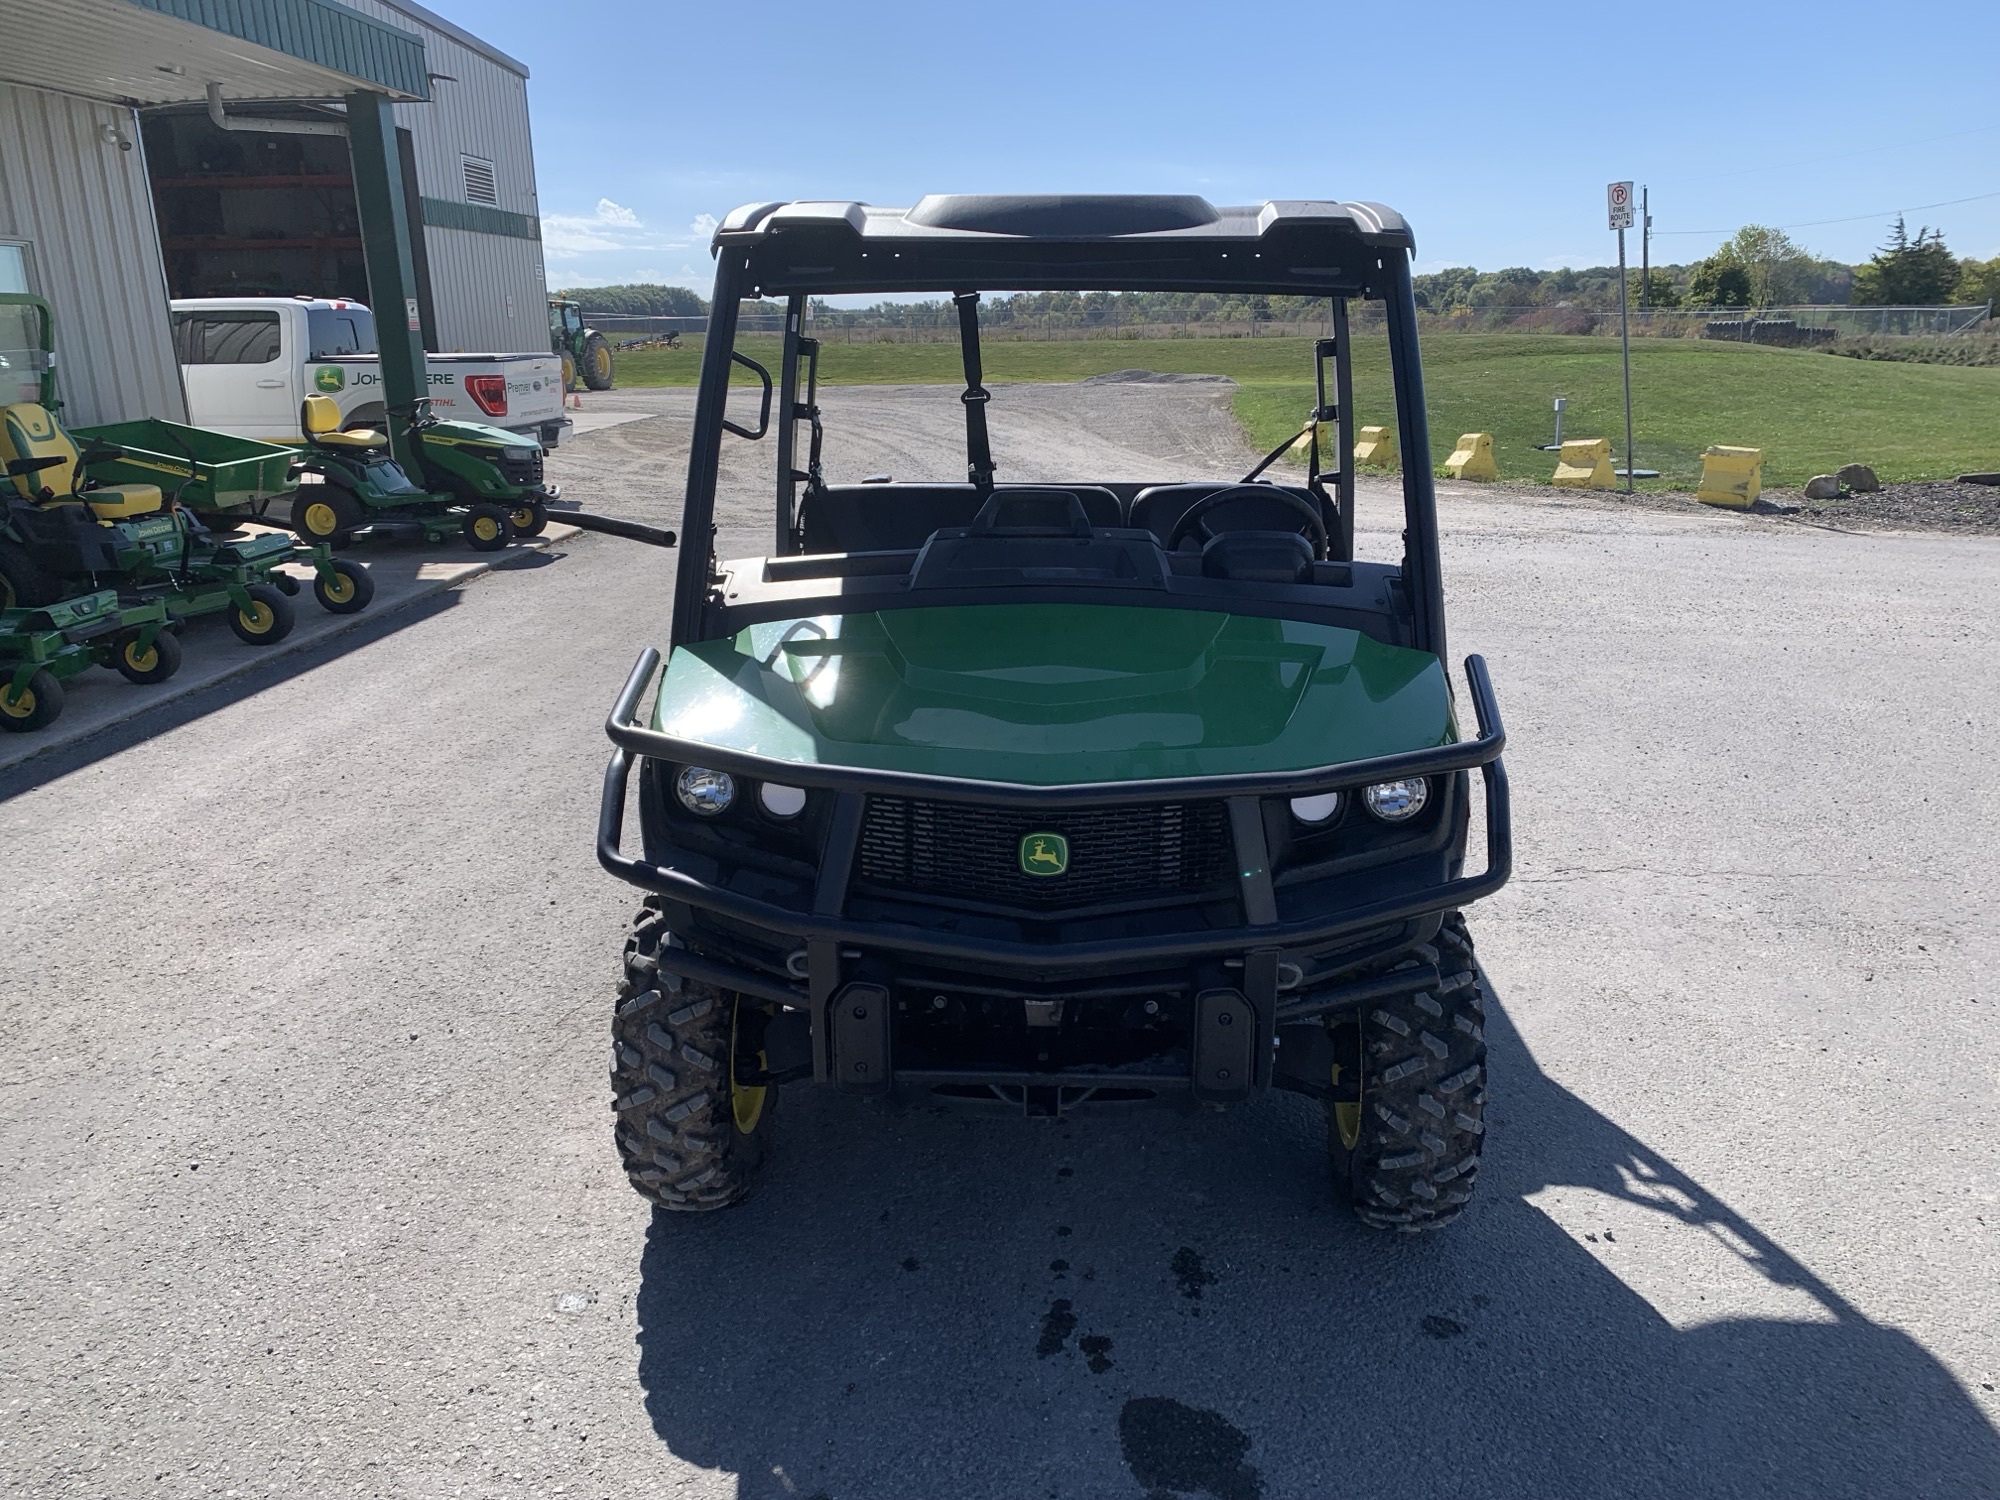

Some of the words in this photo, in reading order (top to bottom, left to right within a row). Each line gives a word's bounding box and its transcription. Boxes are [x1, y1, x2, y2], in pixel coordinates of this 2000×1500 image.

[1610, 213, 1630, 221] ROUTE
[351, 372, 382, 386] JOH
[426, 373, 455, 385] ERE
[507, 381, 531, 394] Premier
[138, 528, 154, 538] JOHN
[153, 524, 173, 534] DEERE
